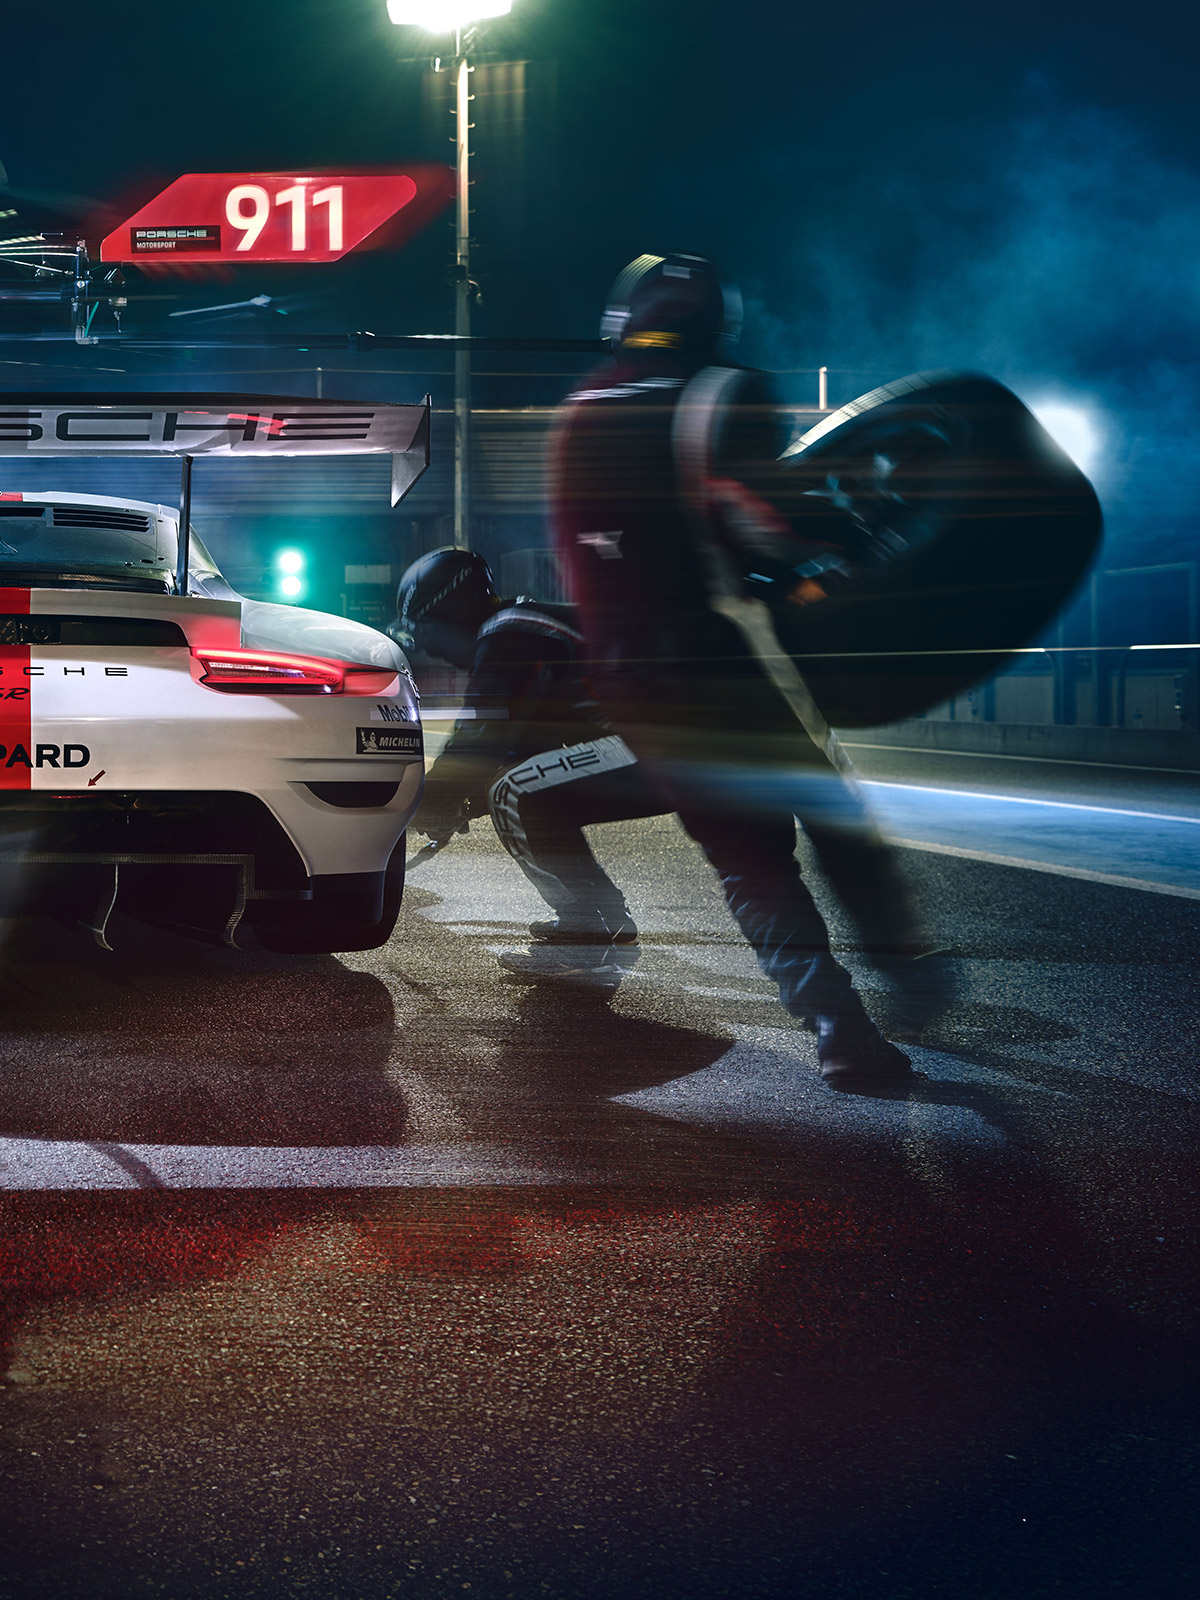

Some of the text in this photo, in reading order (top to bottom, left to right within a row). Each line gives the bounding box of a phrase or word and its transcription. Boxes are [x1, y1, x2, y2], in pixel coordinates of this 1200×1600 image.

[225, 184, 344, 251] 911
[136, 229, 207, 238] PORSCHE
[136, 241, 176, 249] MOTORSPORT
[379, 736, 420, 748] MICHELIN
